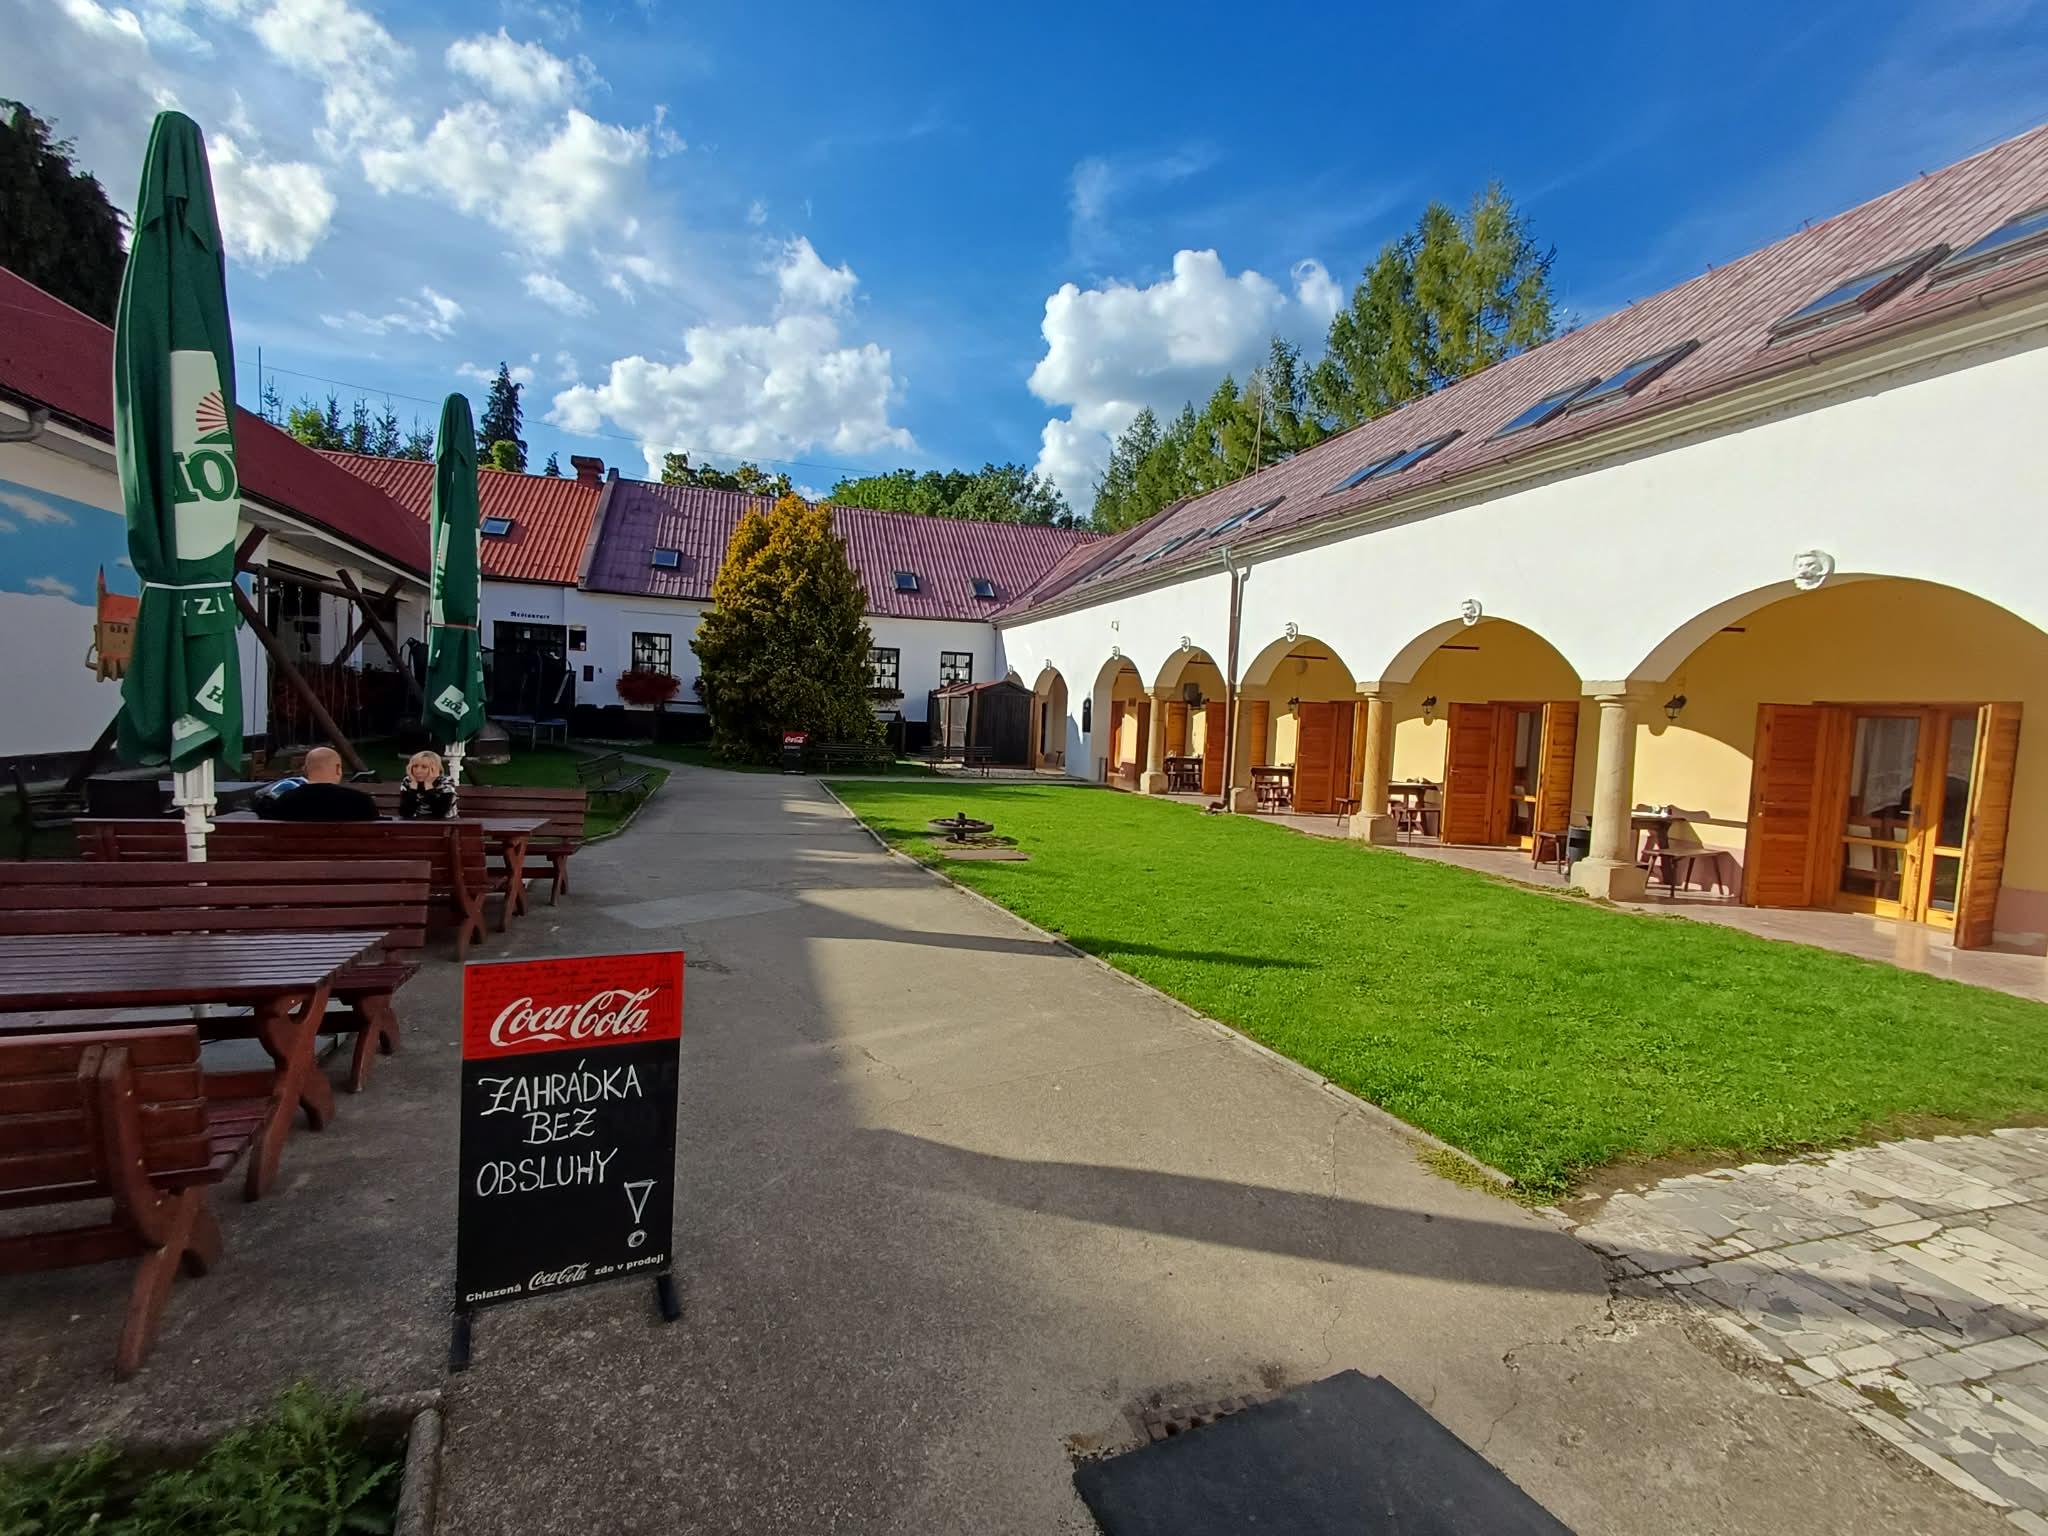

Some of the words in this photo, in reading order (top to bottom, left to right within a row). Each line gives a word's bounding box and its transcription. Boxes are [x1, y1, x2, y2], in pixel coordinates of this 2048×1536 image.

[489, 987, 660, 1047] Coca-Cola
[478, 1058, 642, 1116] ZAHRÁDKA
[522, 1108, 597, 1145] BEZ
[476, 1147, 618, 1197] OBSLUHY
[465, 1284, 522, 1302] Chlazená
[528, 1262, 591, 1291] Coca-Cola
[594, 1265, 614, 1276] zde
[617, 1262, 624, 1270] v
